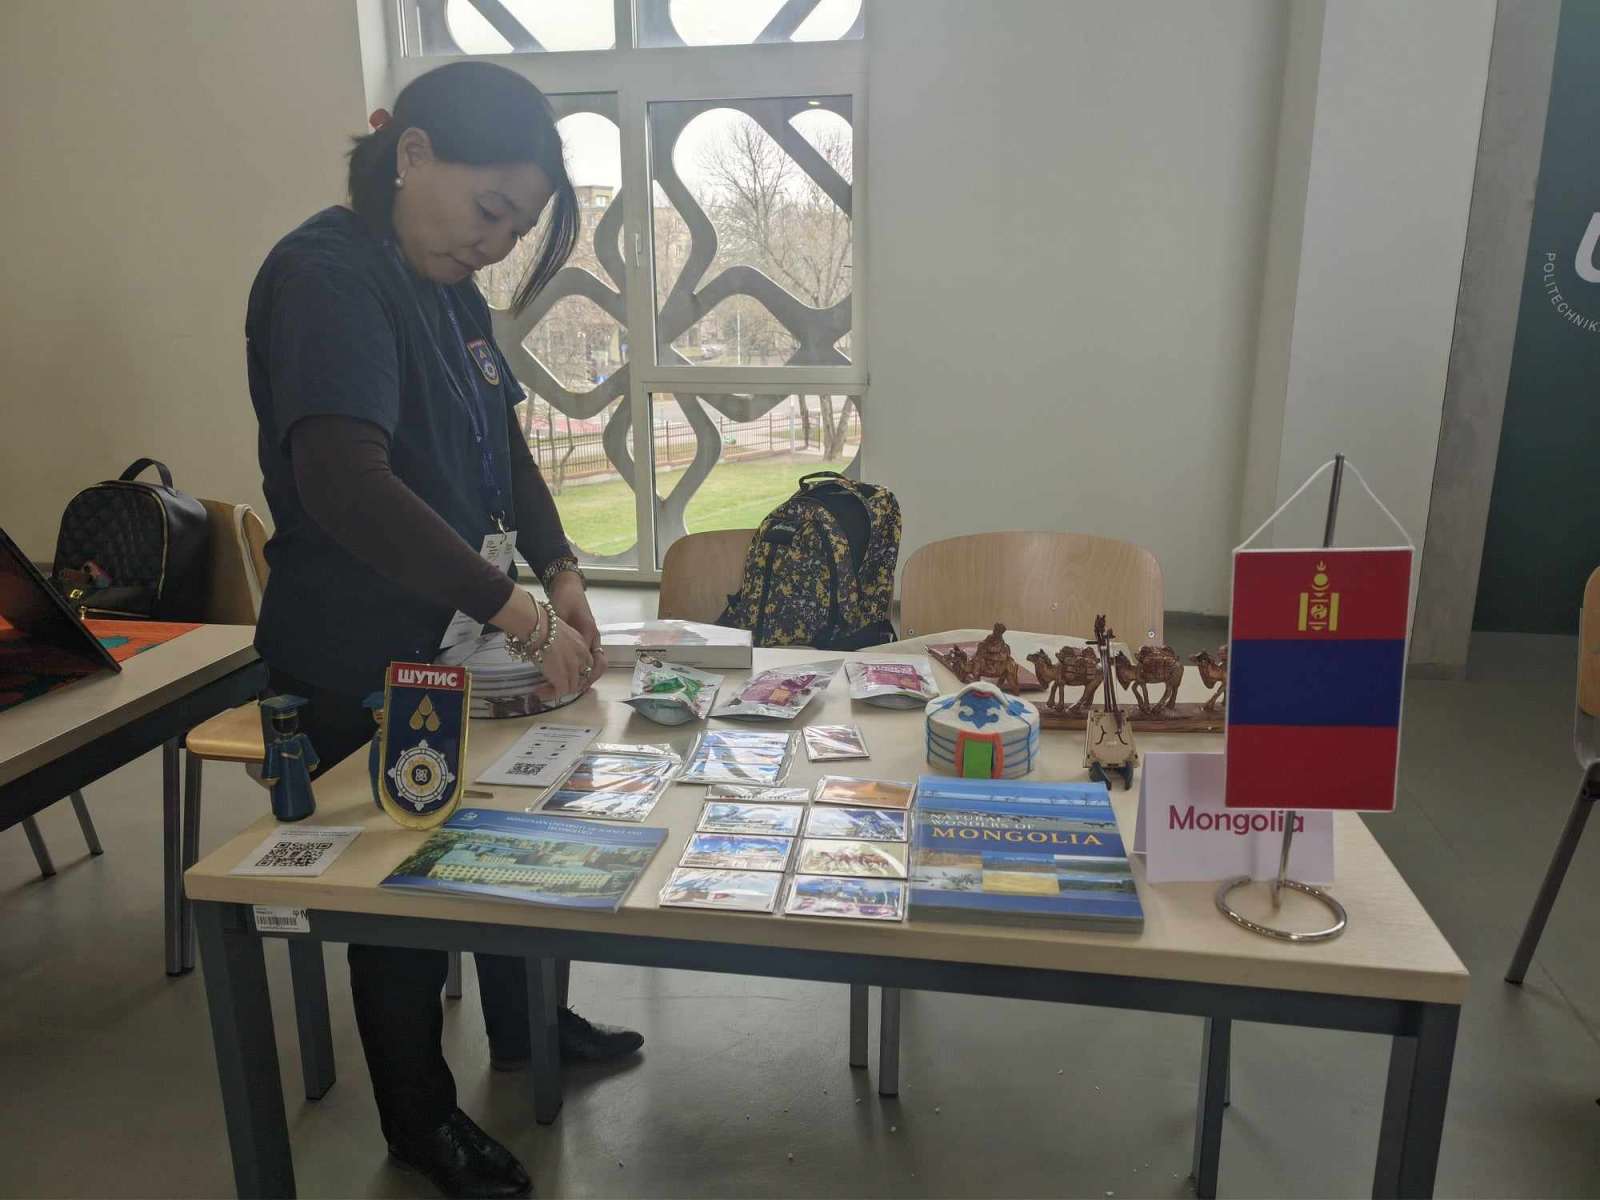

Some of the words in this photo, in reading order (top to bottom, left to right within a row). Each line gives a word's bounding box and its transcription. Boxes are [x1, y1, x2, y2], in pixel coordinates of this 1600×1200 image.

[1543, 252, 1600, 332] POLITECHNIK
[398, 669, 458, 687] ШУТИС
[1169, 804, 1304, 834] Mongolia
[932, 828, 1103, 845] MONGOLIA
